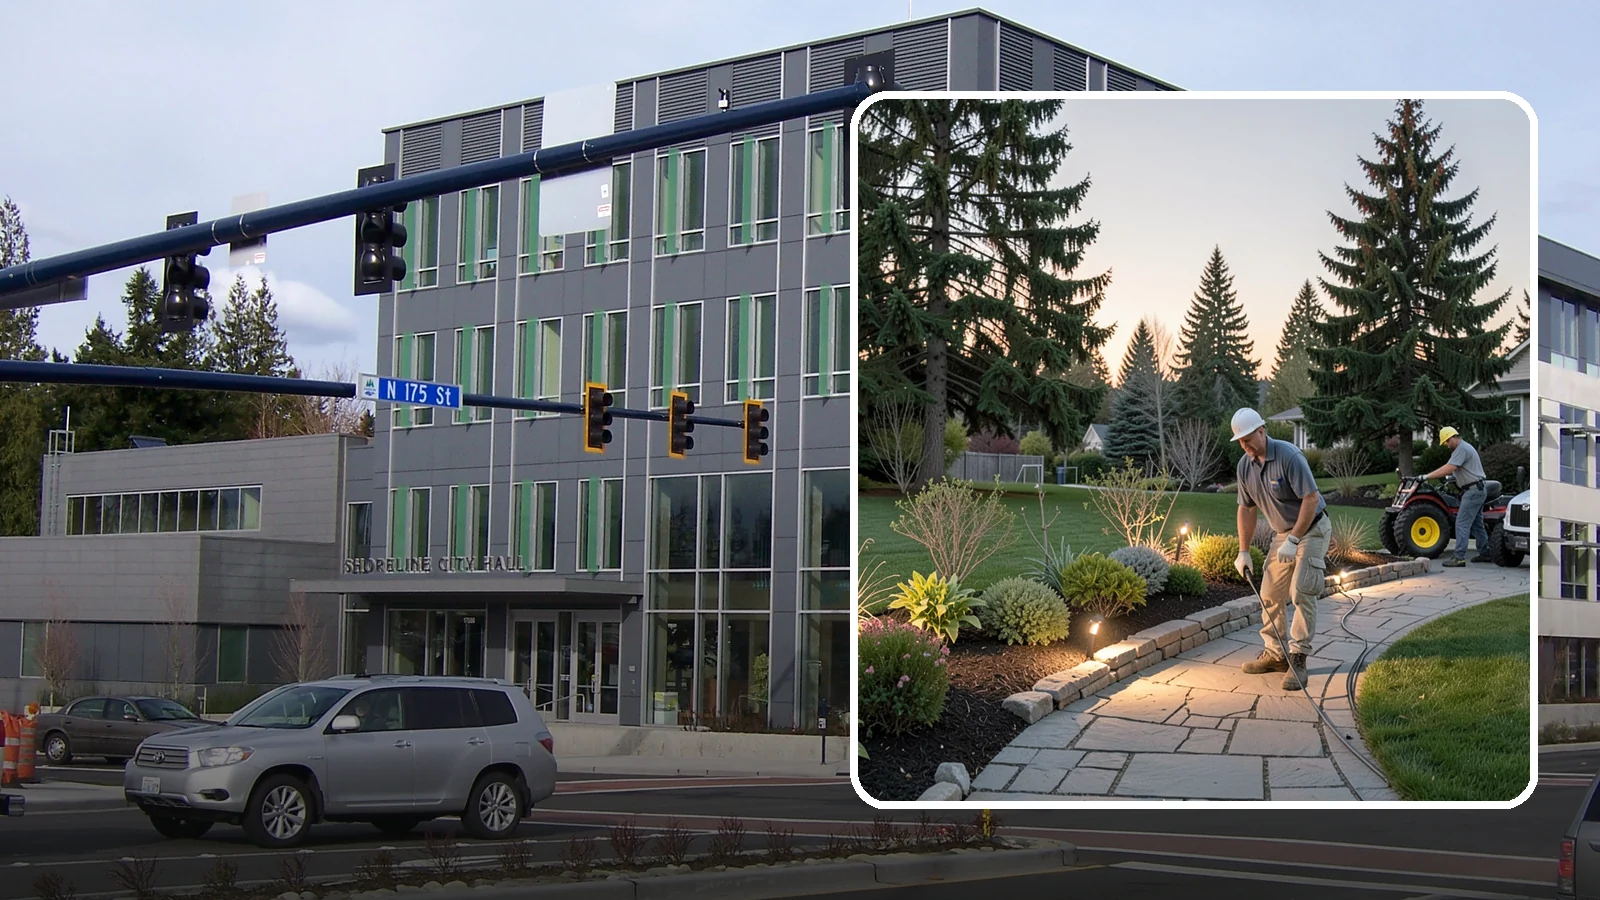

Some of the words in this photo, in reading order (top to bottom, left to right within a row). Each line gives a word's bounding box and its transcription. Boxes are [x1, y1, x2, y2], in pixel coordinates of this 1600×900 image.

[387, 380, 396, 400] N
[405, 382, 428, 403] 175
[436, 386, 452, 406] St
[344, 556, 432, 574] SHORELINE
[438, 556, 476, 573] CITY
[484, 555, 526, 572] HALL
